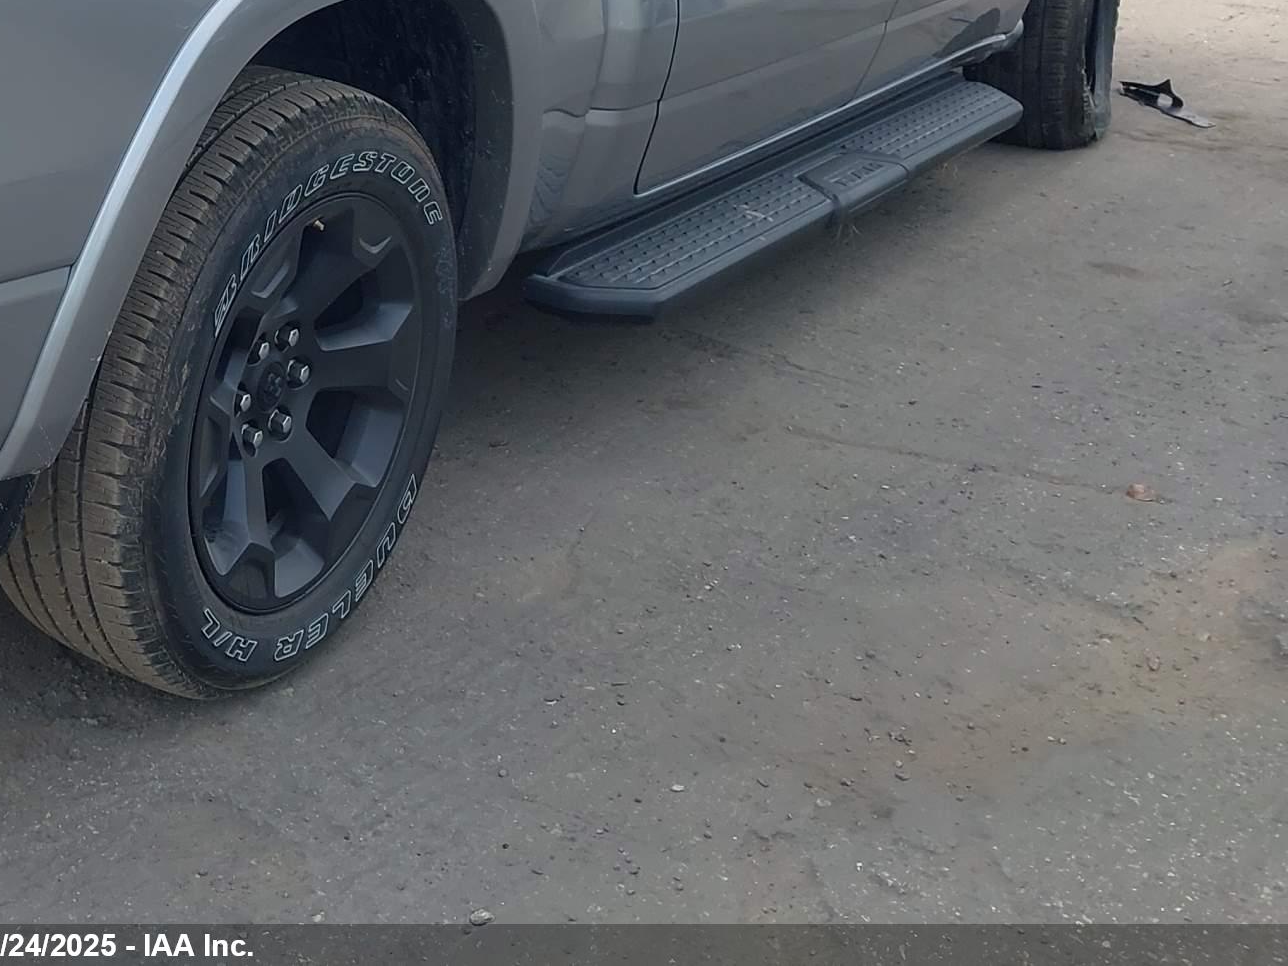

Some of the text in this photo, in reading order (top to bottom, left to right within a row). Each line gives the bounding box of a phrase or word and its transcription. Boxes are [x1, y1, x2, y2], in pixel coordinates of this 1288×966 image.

[214, 150, 443, 338] BRIDGESTONE
[201, 473, 418, 662] DUELER H/L
